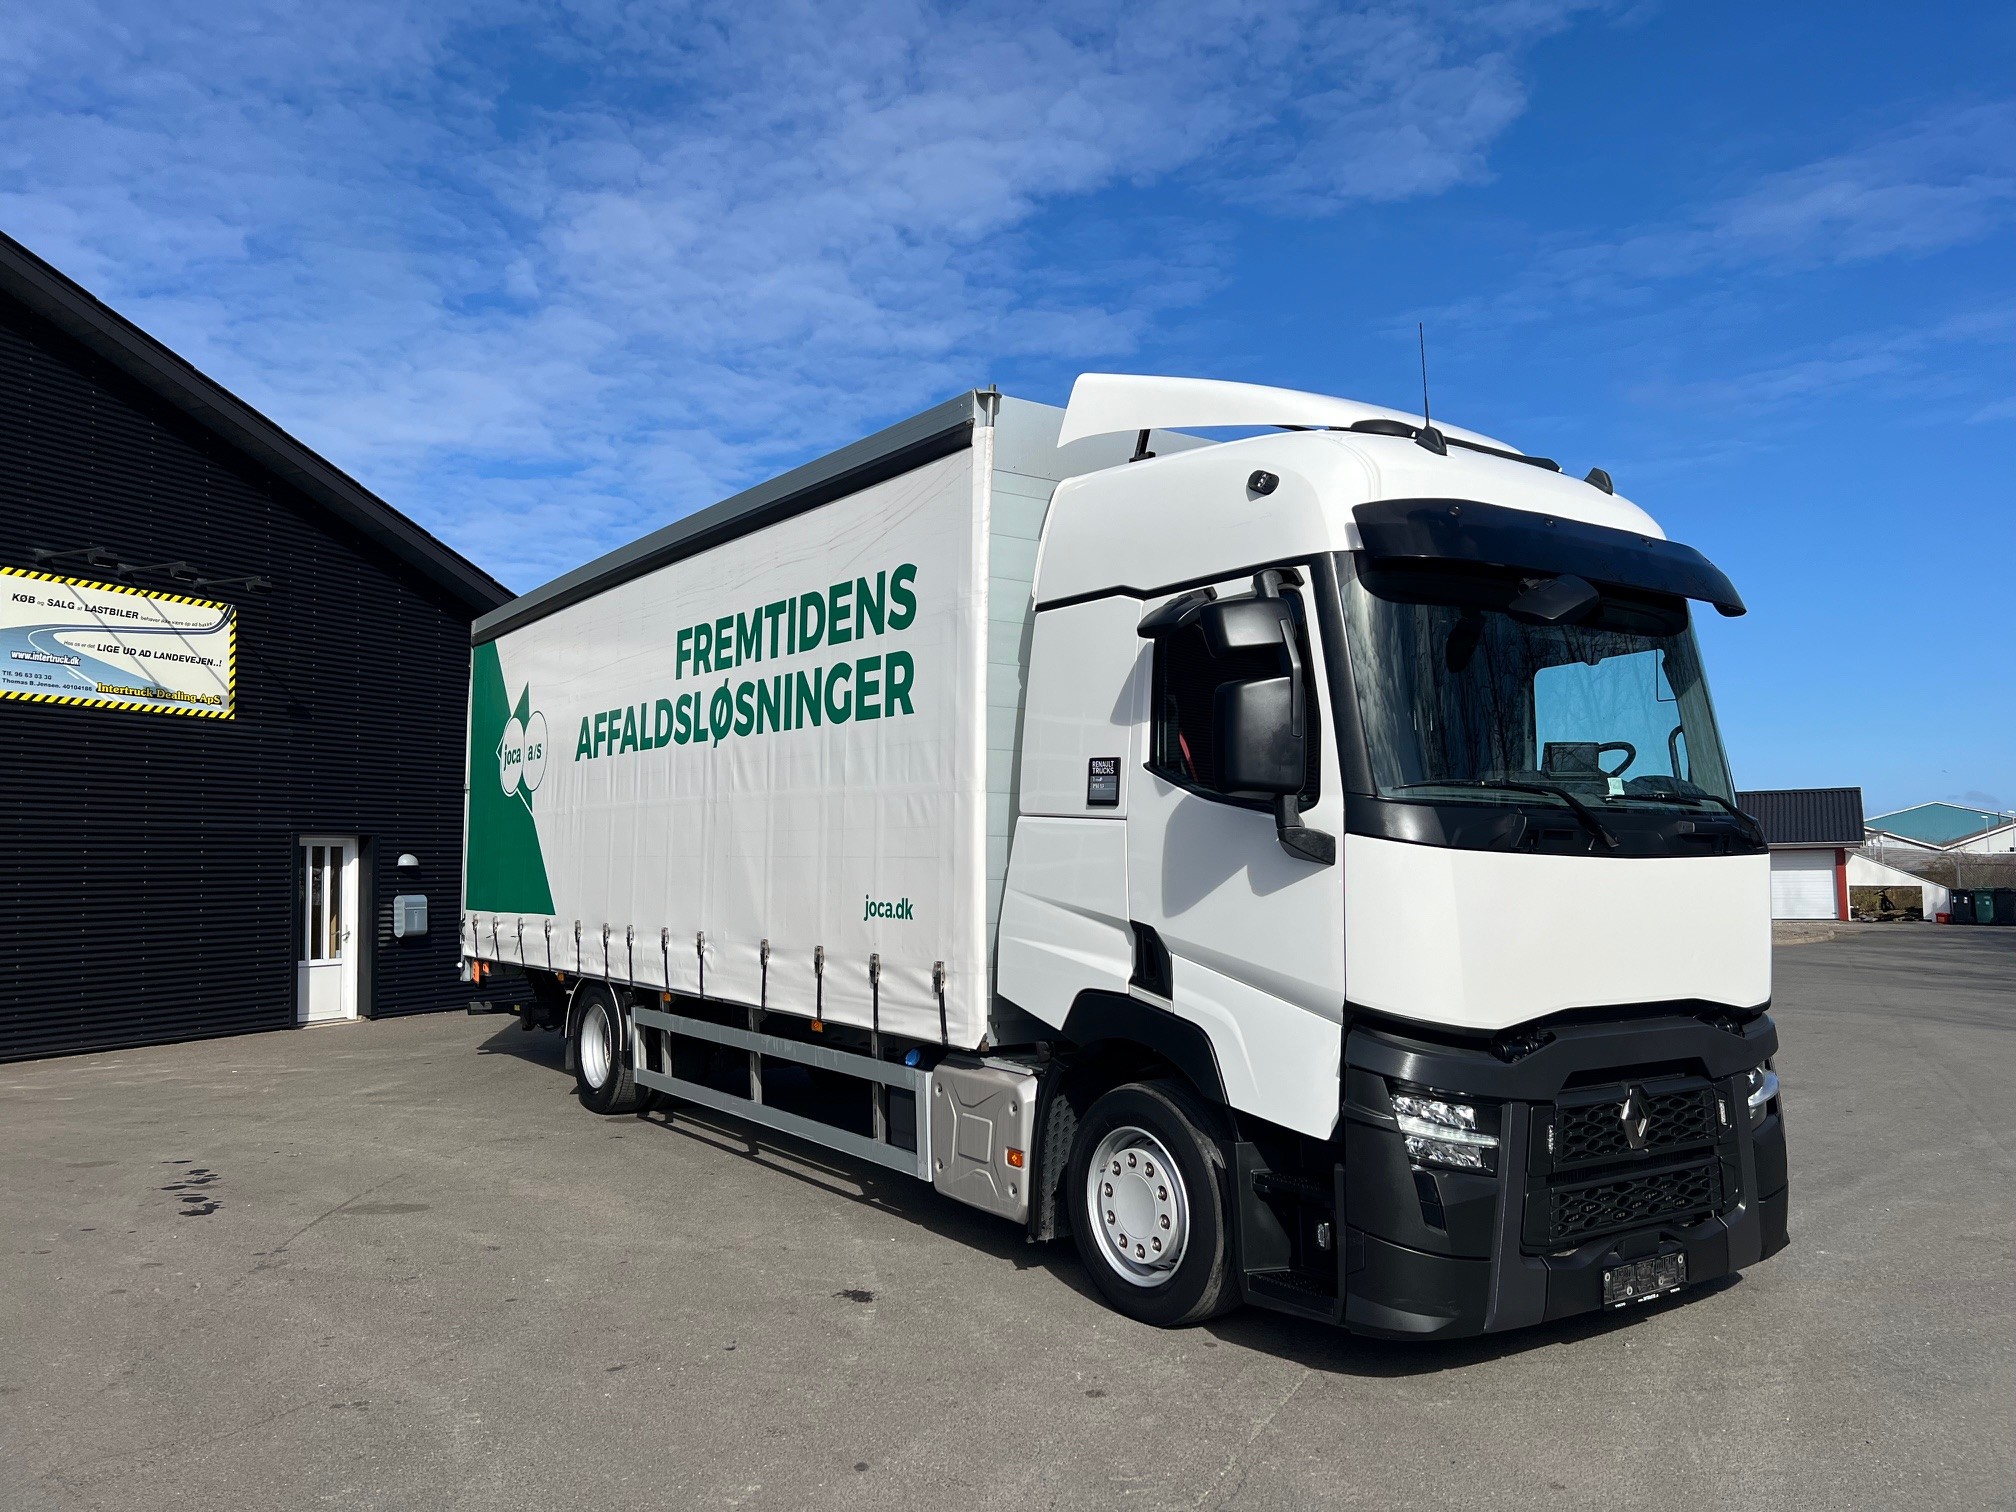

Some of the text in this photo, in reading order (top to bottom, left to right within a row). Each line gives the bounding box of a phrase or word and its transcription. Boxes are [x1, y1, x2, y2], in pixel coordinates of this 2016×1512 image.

[11, 593, 36, 604] KØB
[46, 598, 75, 610] SALG
[84, 604, 139, 620] LASTBILER
[675, 563, 918, 680] FREMTIDENS
[11, 651, 80, 666] www.intertruck.dk
[97, 644, 120, 654] LIGE
[122, 646, 137, 656] UD
[138, 649, 151, 658] AD
[97, 682, 222, 705] Intertruck Dealing ApS
[575, 650, 915, 762] AFFALDSLØSNINGER
[504, 743, 542, 771] joca a/s
[1091, 760, 1115, 768] RENAULT
[1091, 767, 1115, 775] TRUCKS
[863, 894, 914, 922] joca.dk
